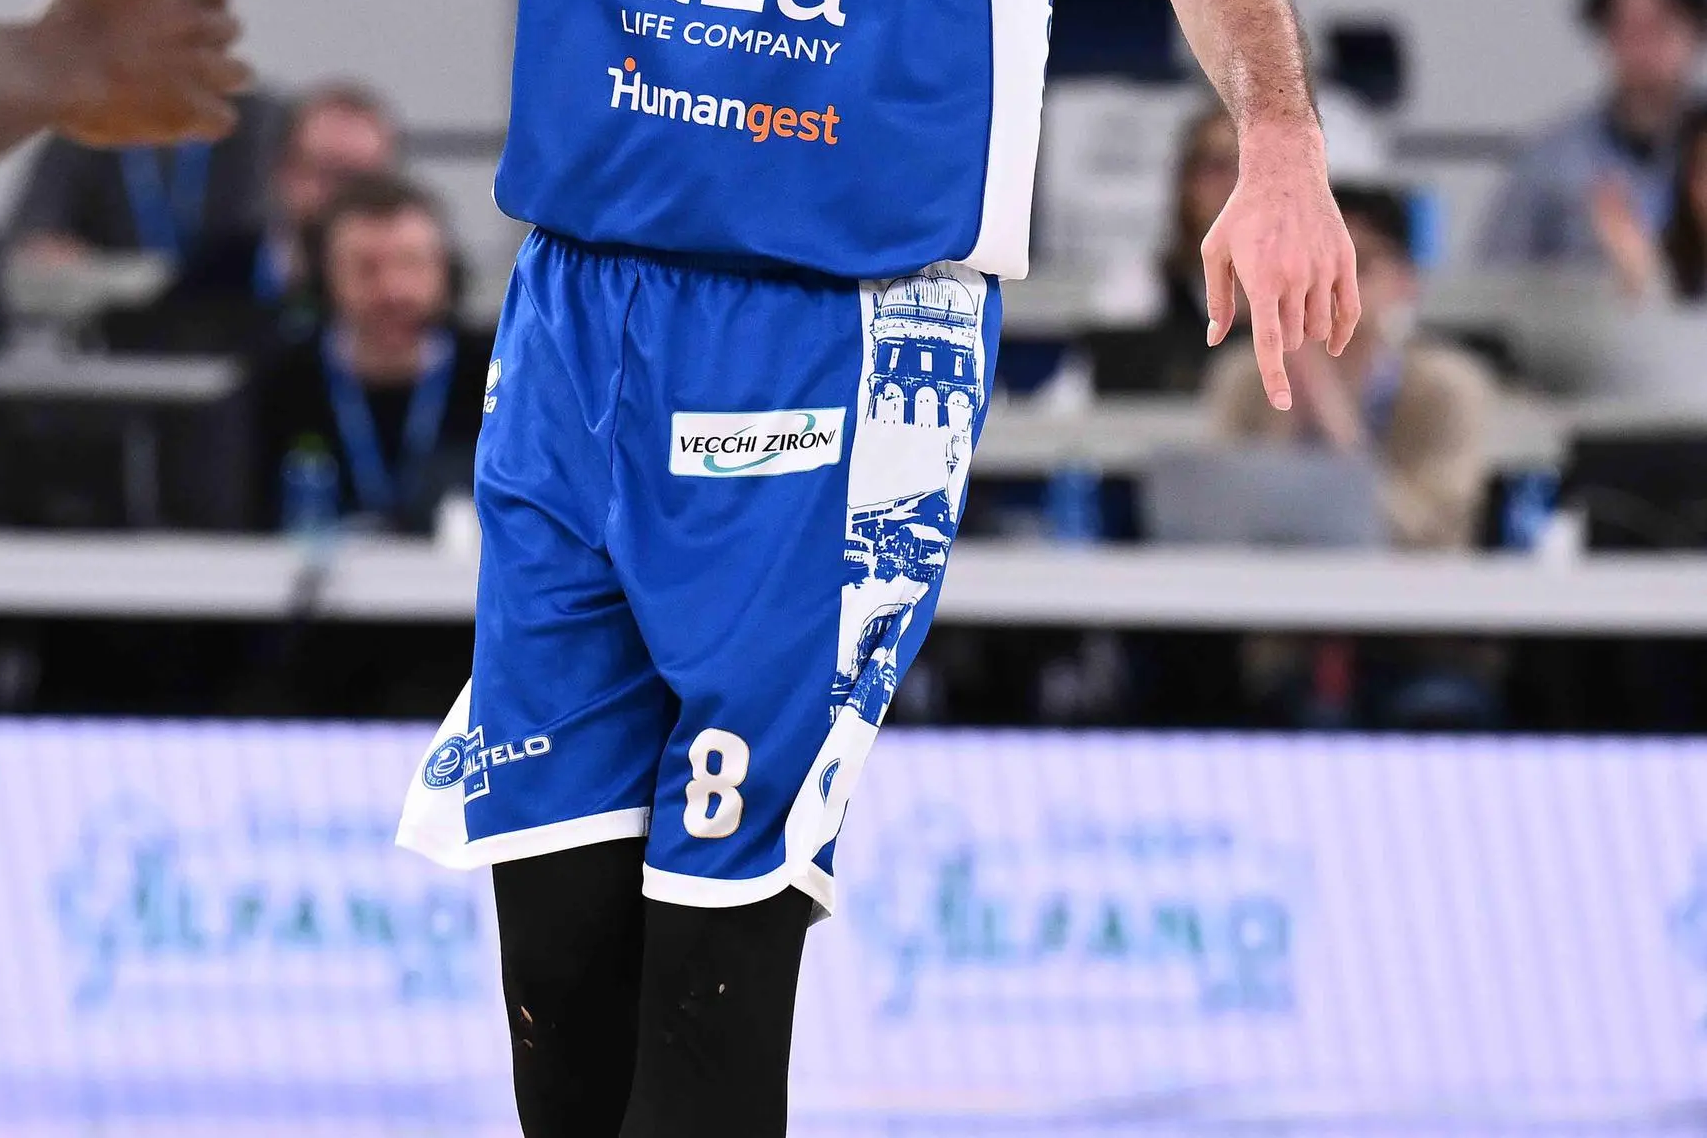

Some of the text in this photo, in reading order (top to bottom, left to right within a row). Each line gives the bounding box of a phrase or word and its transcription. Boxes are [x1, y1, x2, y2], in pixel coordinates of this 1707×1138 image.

[621, 9, 842, 65] LIFE COMPANY
[608, 57, 840, 145] Humangest
[680, 435, 757, 454] VECCHI
[683, 728, 750, 838] 8
